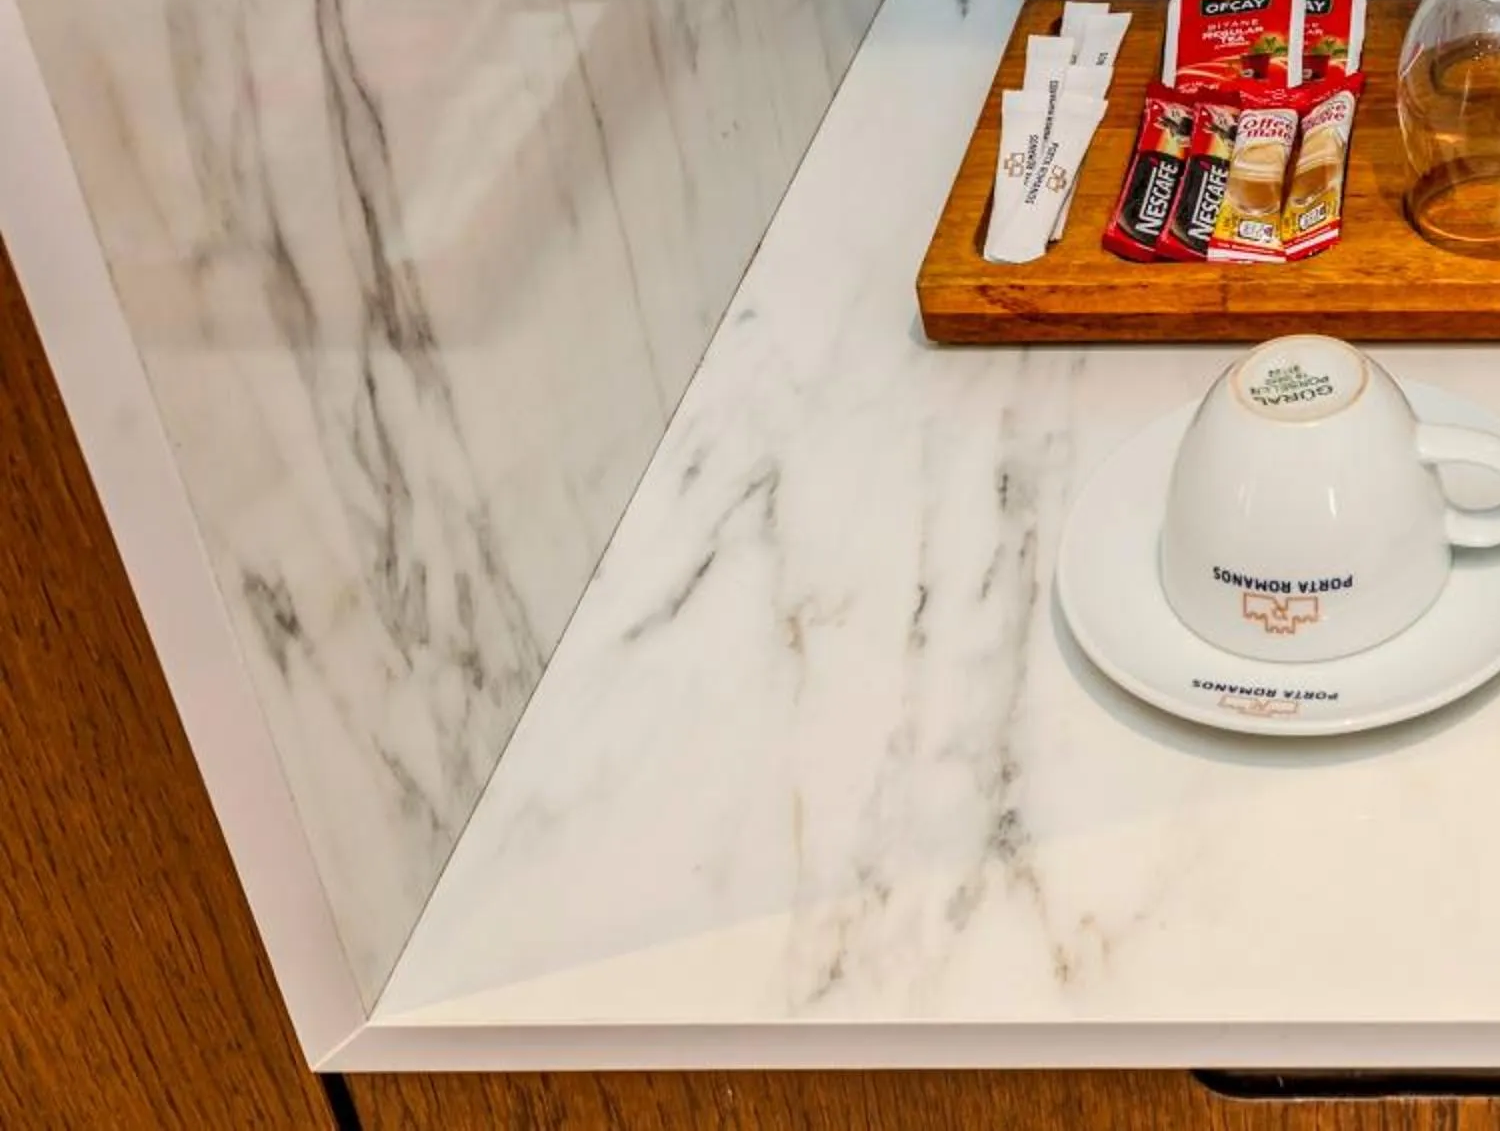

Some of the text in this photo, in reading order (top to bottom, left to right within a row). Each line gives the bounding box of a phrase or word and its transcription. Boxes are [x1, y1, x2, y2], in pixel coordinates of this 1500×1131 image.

[1212, 566, 1354, 595] PORTA ROMANOS
[1190, 678, 1339, 701] PORTA ROMANOS
